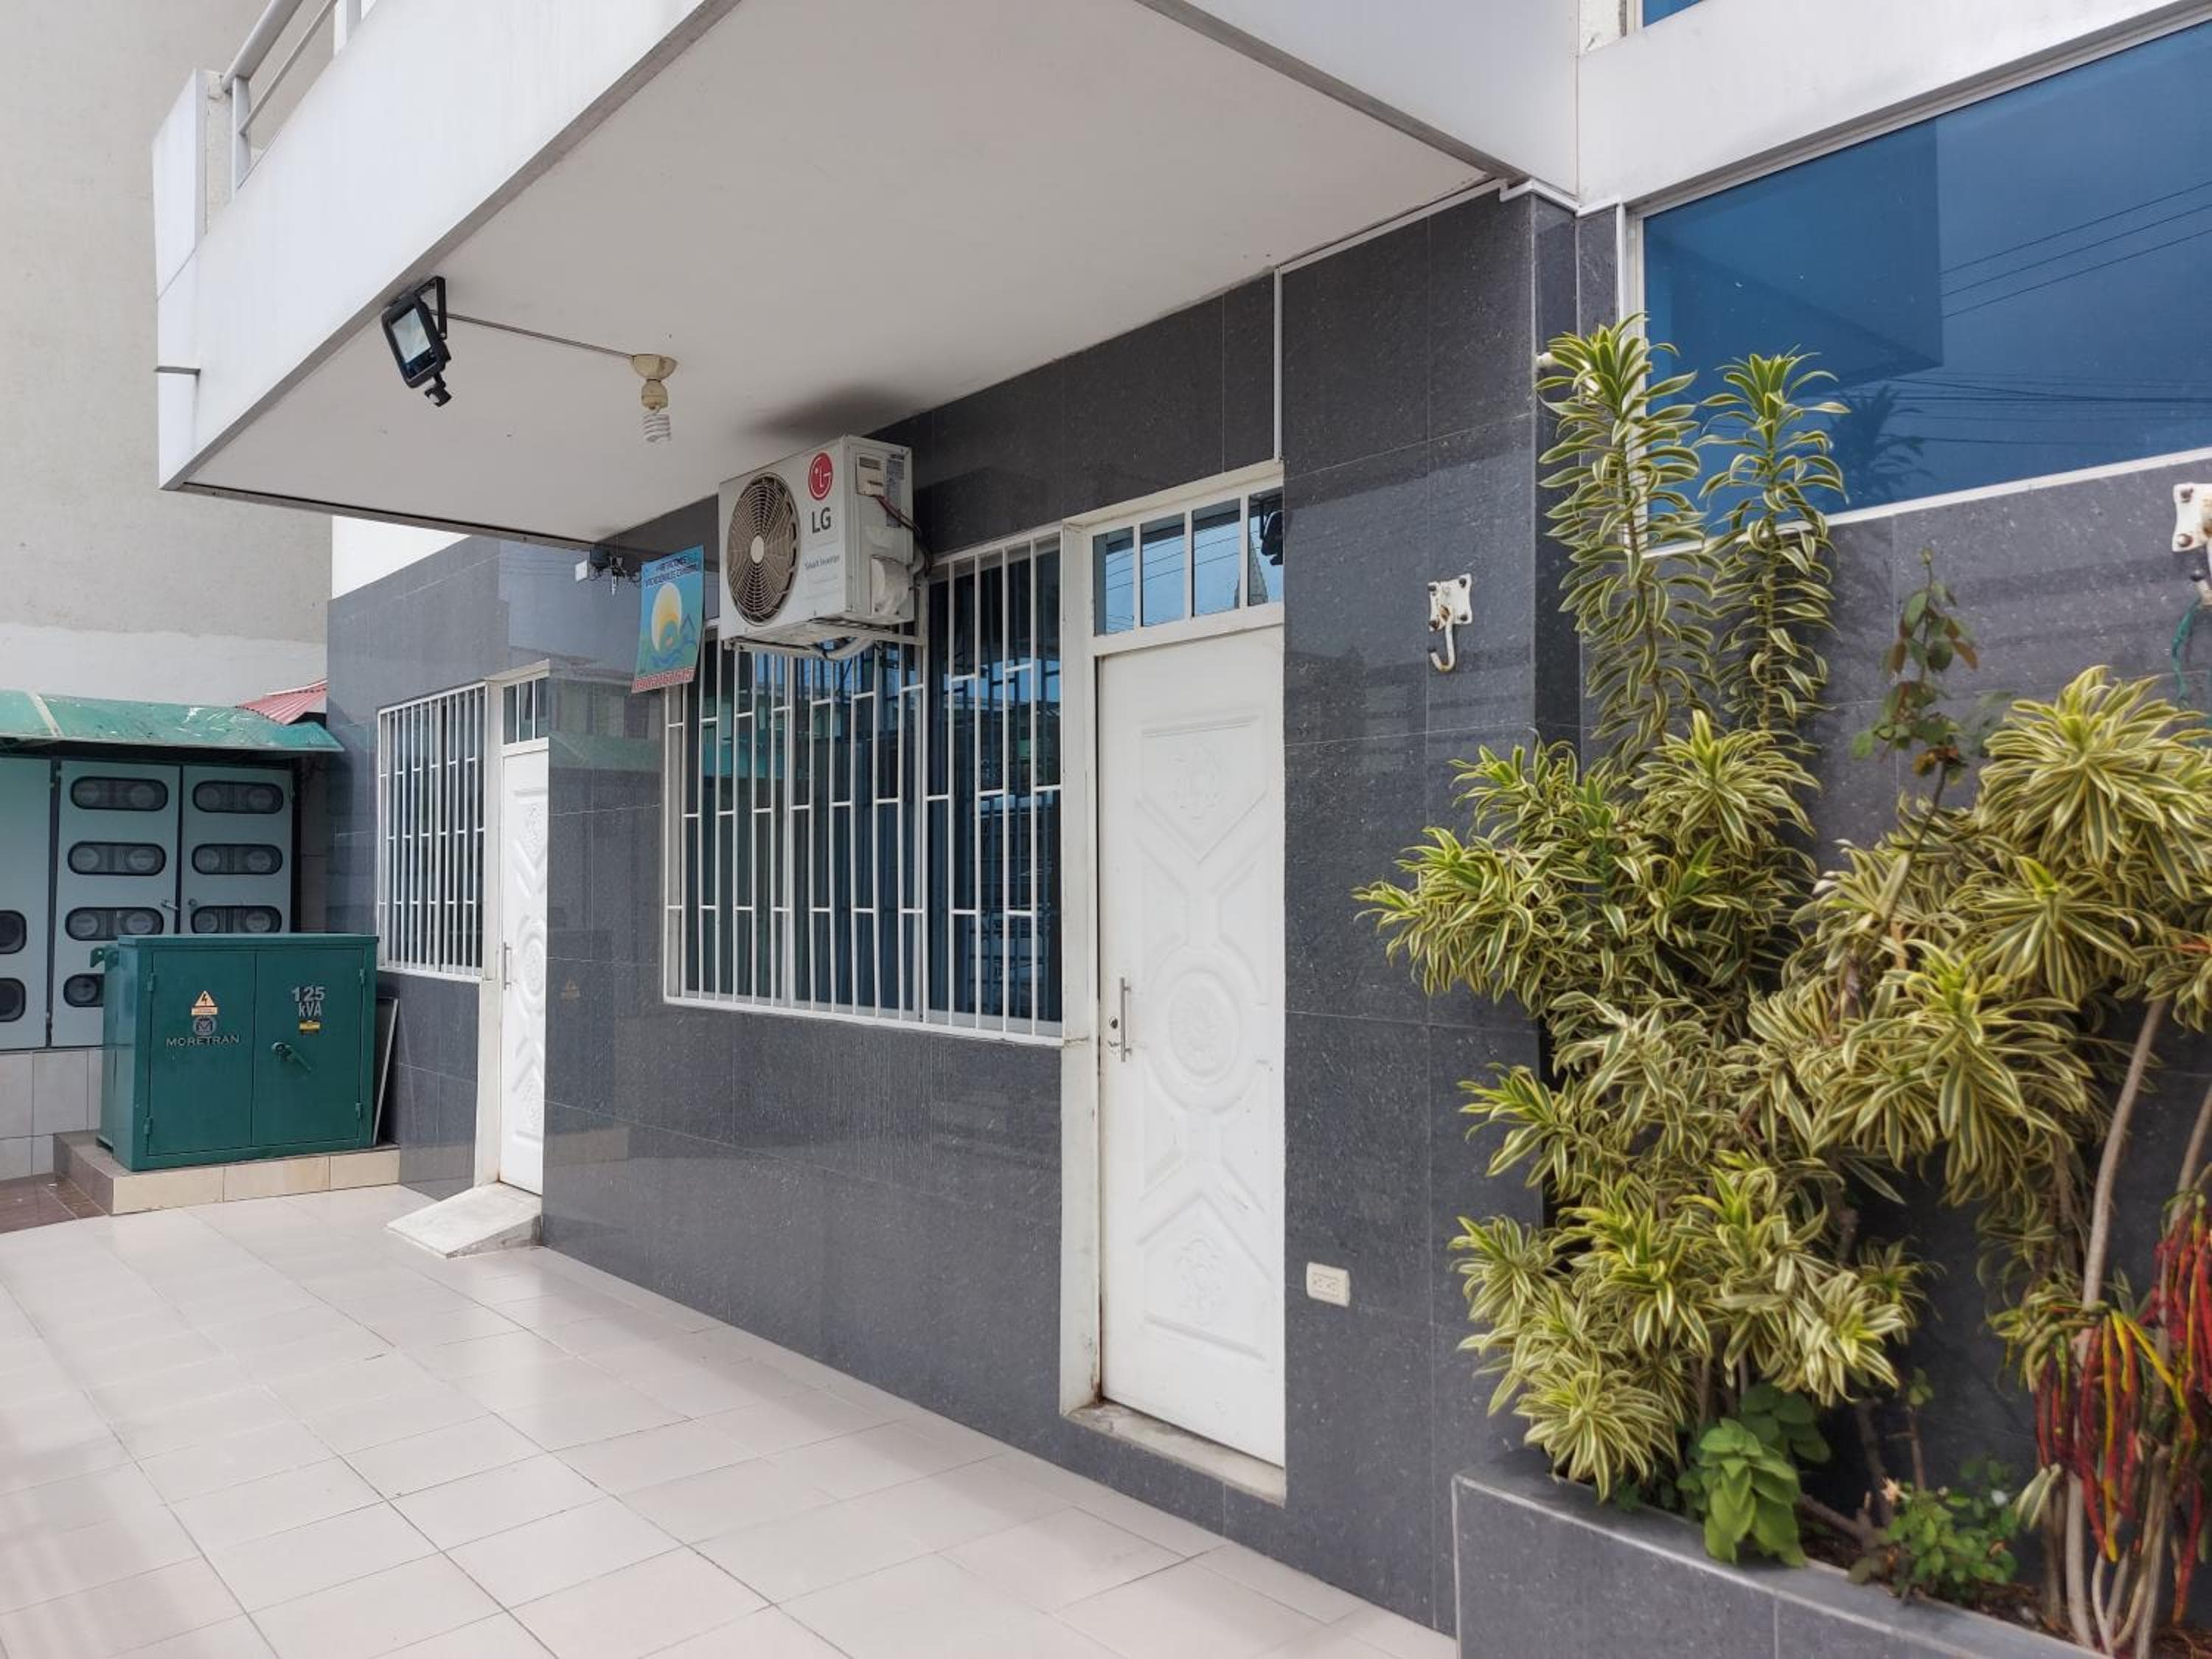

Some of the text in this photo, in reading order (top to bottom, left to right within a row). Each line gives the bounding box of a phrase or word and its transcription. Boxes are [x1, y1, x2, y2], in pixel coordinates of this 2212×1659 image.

[812, 507, 831, 534] LG
[291, 986, 325, 1001] 125
[166, 1033, 240, 1047] MORETRAN
